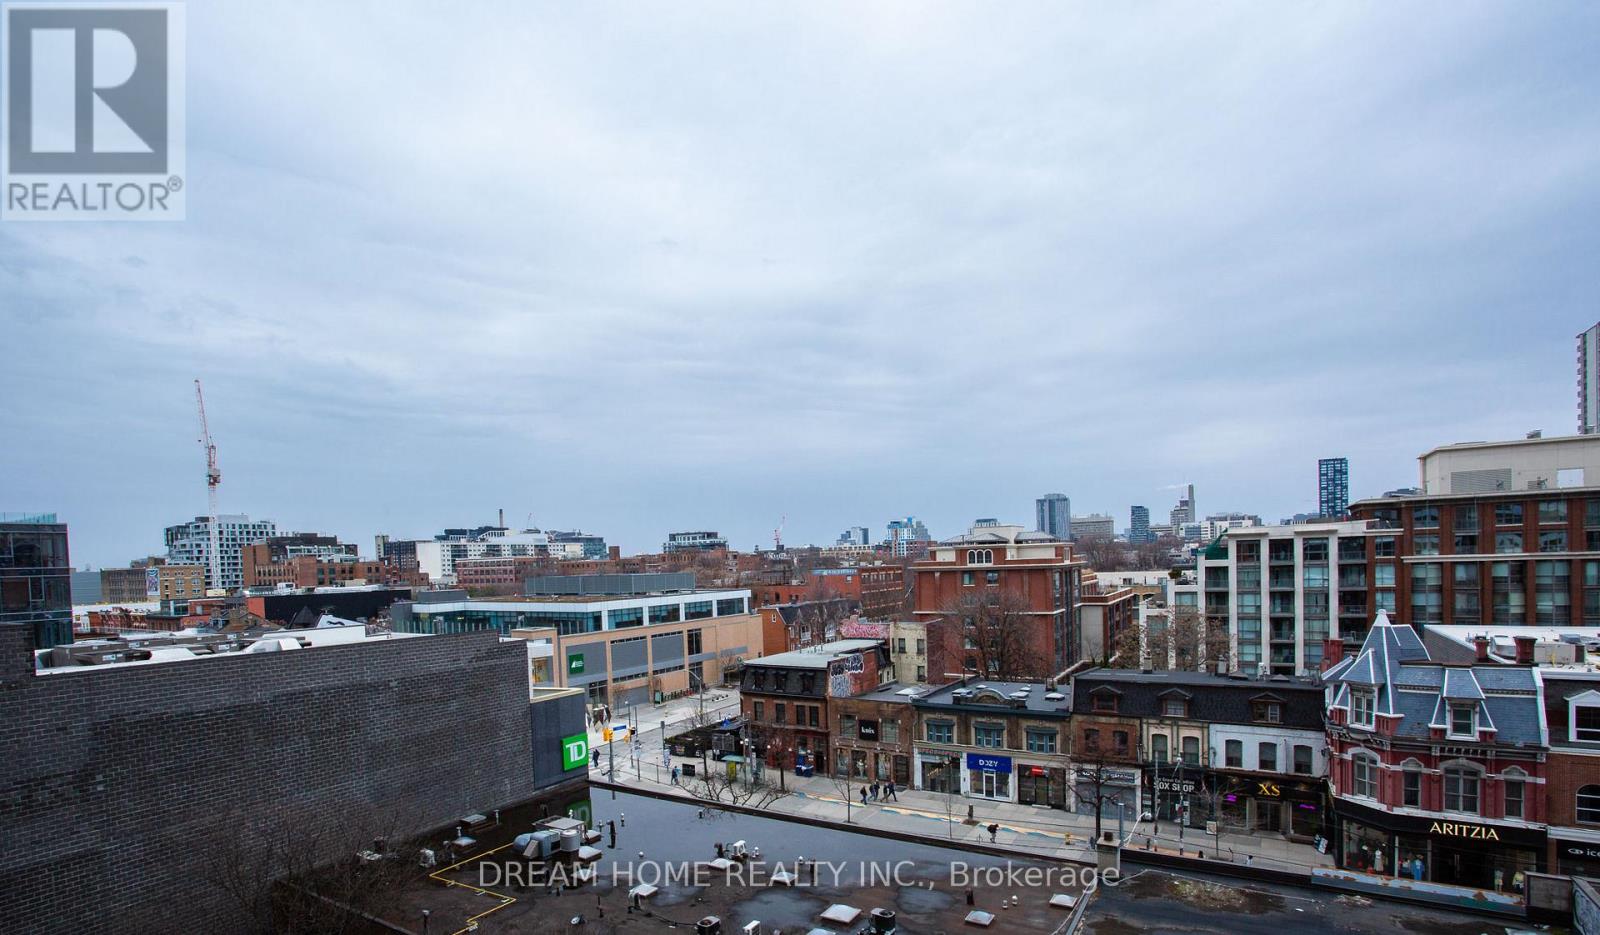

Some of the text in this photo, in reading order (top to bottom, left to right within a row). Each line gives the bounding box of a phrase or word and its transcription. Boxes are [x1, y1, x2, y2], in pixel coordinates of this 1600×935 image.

[565, 740, 587, 762] TD
[1258, 782, 1281, 797] XS
[1429, 821, 1500, 841] ARITZIA
